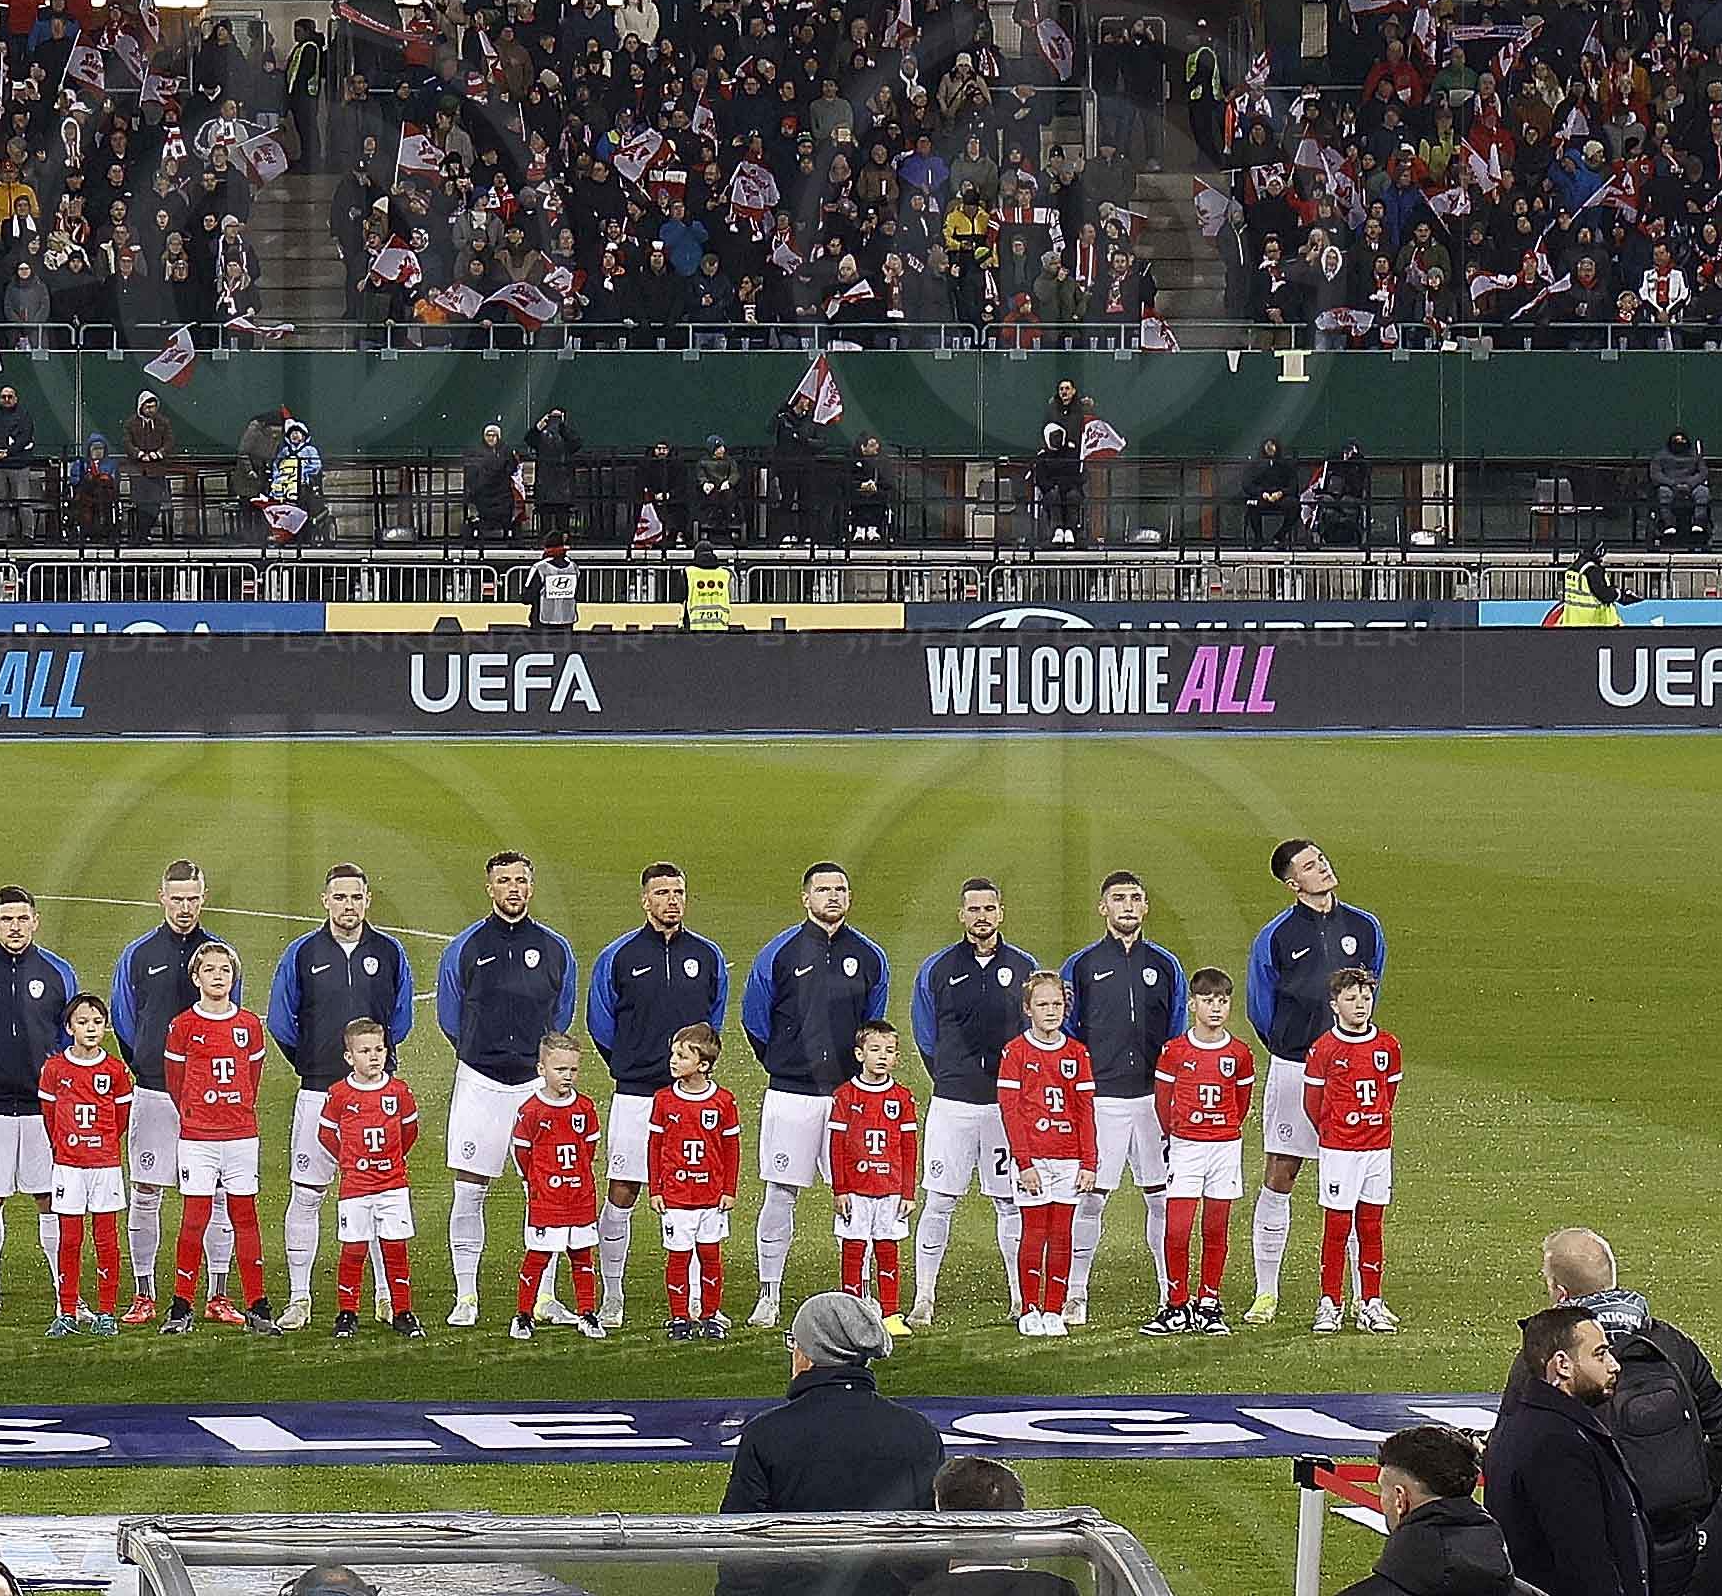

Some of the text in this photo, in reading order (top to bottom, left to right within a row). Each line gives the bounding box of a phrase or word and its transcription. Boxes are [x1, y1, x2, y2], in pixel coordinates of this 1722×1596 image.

[410, 652, 602, 713] UEFA
[925, 644, 1276, 715] WELCOME ALL
